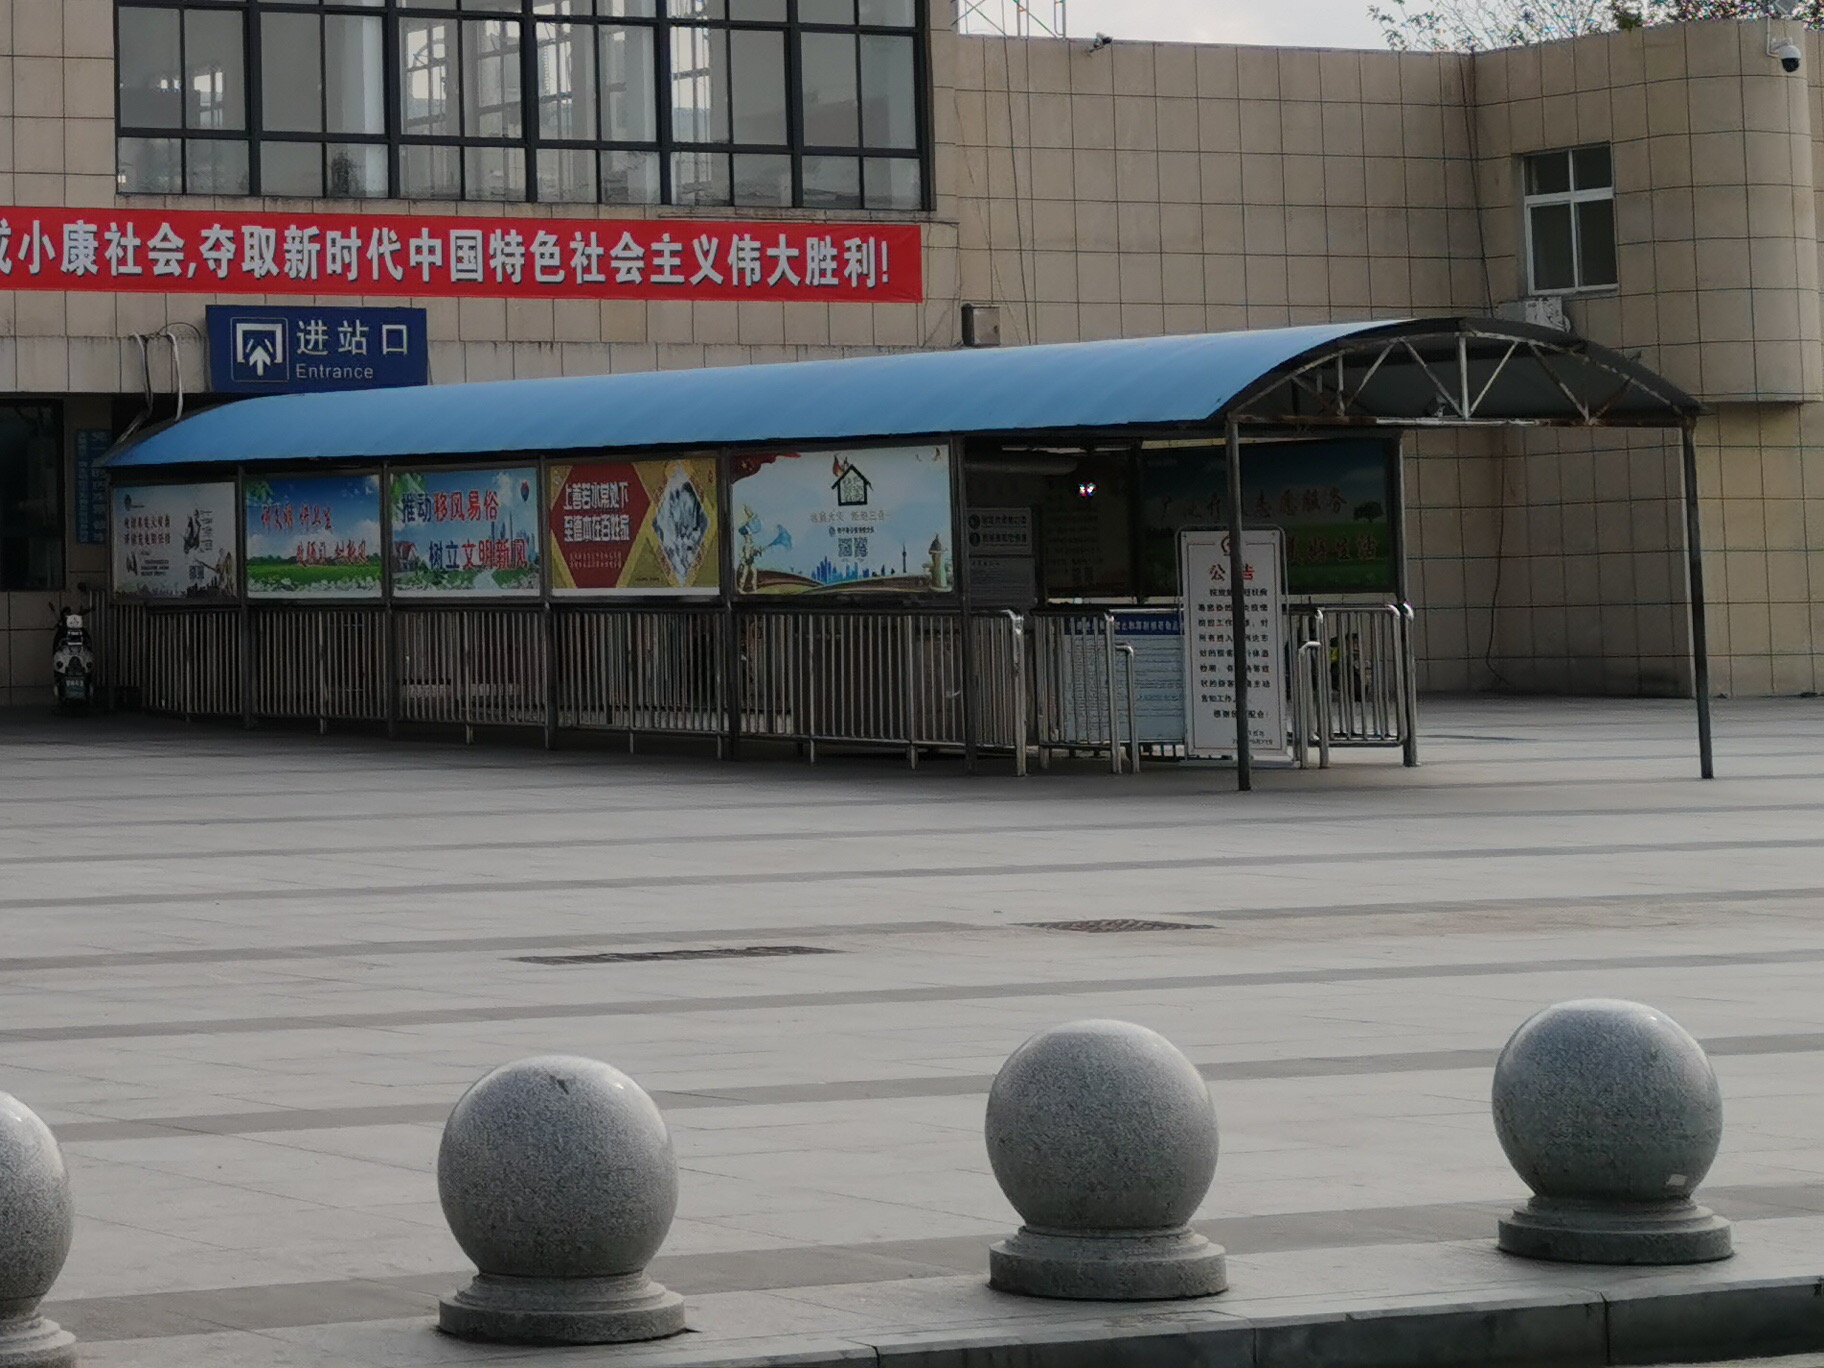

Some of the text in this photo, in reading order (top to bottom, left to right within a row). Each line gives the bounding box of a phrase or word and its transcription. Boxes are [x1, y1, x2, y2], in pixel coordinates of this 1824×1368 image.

[295, 319, 408, 356] 进站口
[295, 363, 374, 379] Entrance
[402, 490, 499, 523] 推动移风易俗
[428, 538, 528, 570] 树立文明新风
